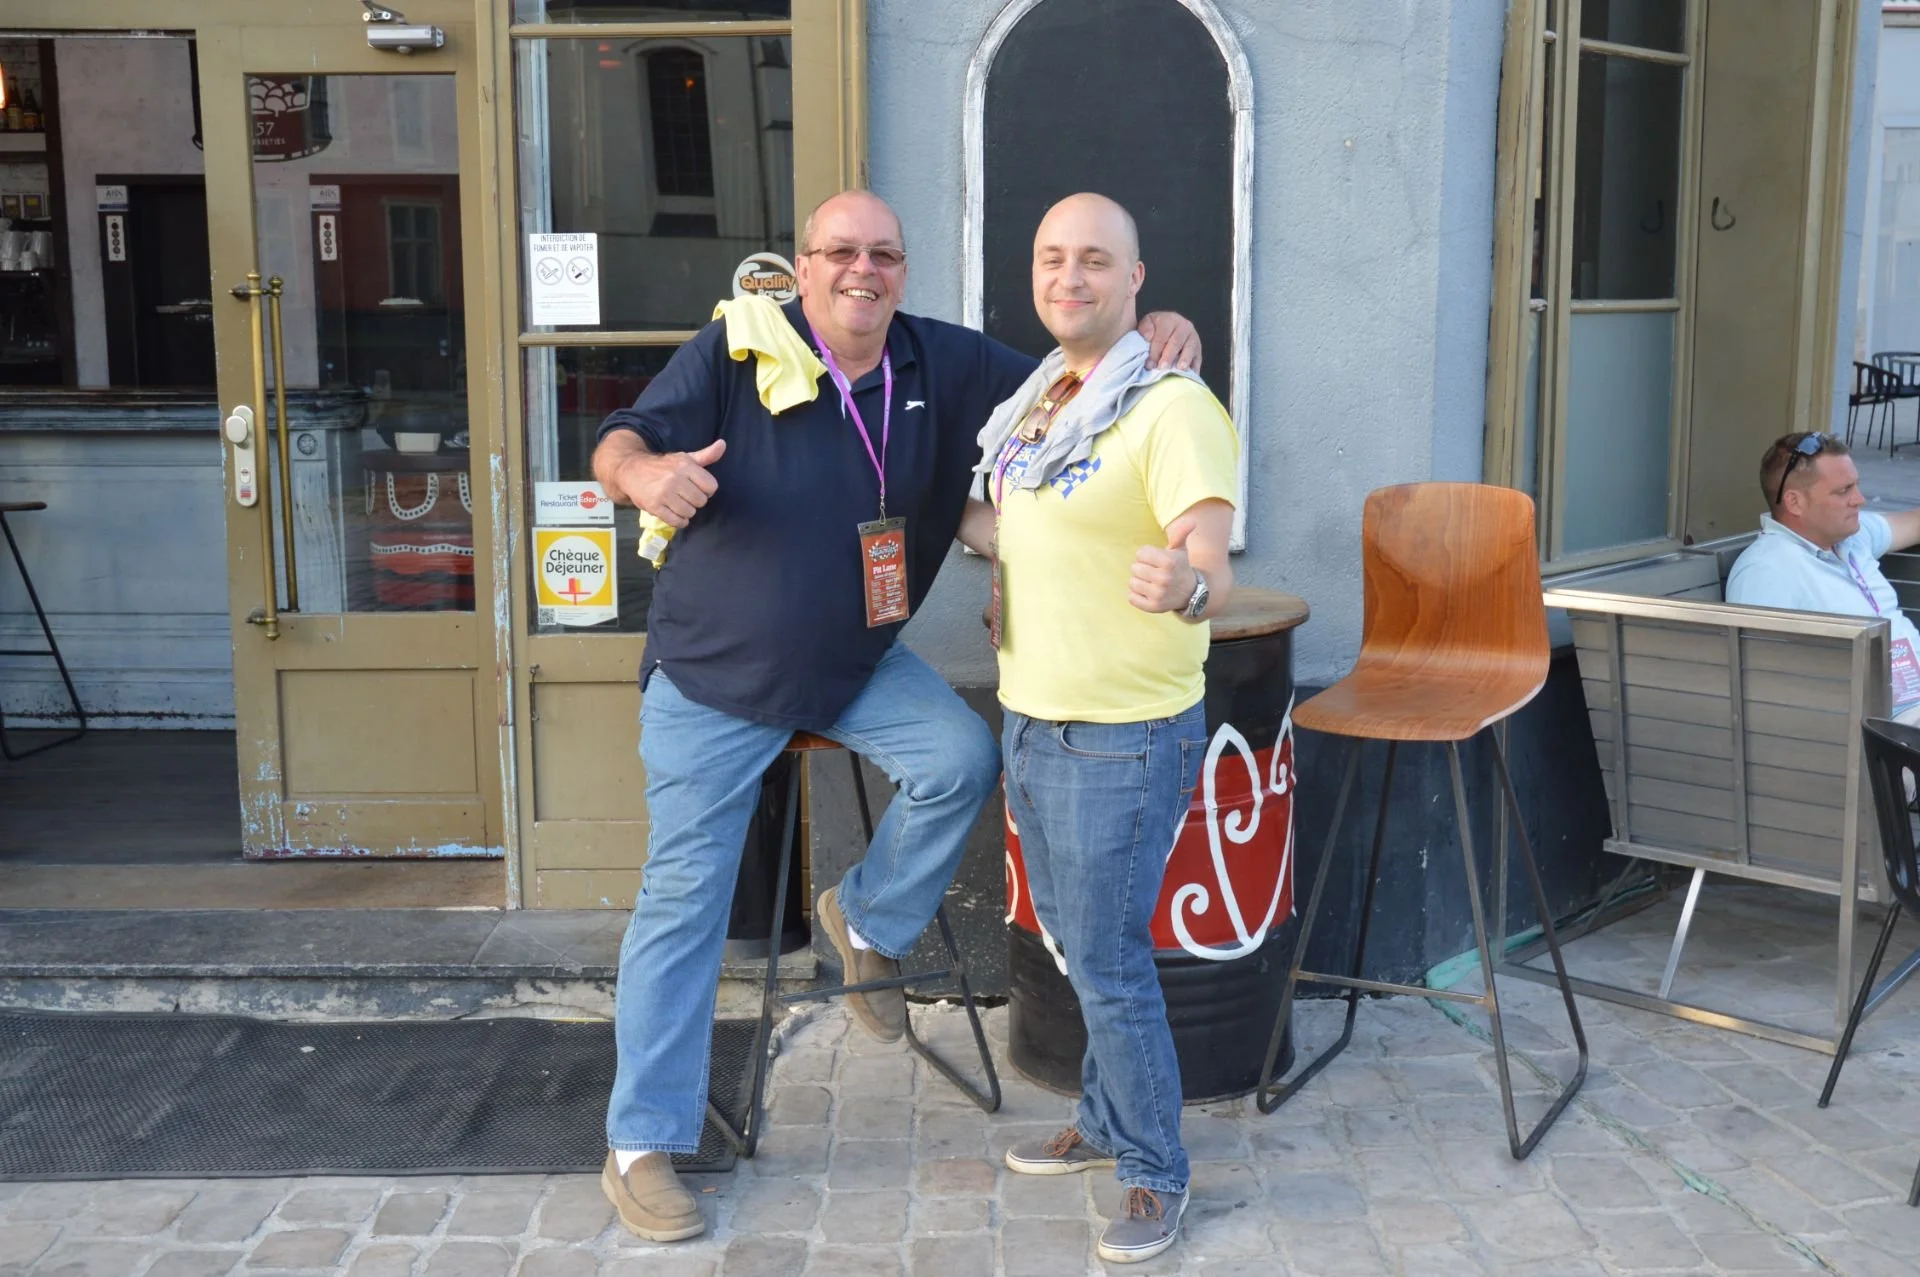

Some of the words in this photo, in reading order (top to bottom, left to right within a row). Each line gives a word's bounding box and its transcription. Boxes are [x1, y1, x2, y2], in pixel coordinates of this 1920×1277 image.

[255, 121, 275, 137] 57
[540, 234, 578, 242] INTERDICTION
[579, 233, 587, 242] DE
[533, 244, 552, 252] FUMER
[553, 244, 560, 252] ET
[561, 244, 568, 252] DE
[569, 243, 594, 252] VAPOTER
[740, 274, 796, 292] Quality
[549, 549, 600, 564] Chèque
[546, 561, 605, 576] Déjeuner
